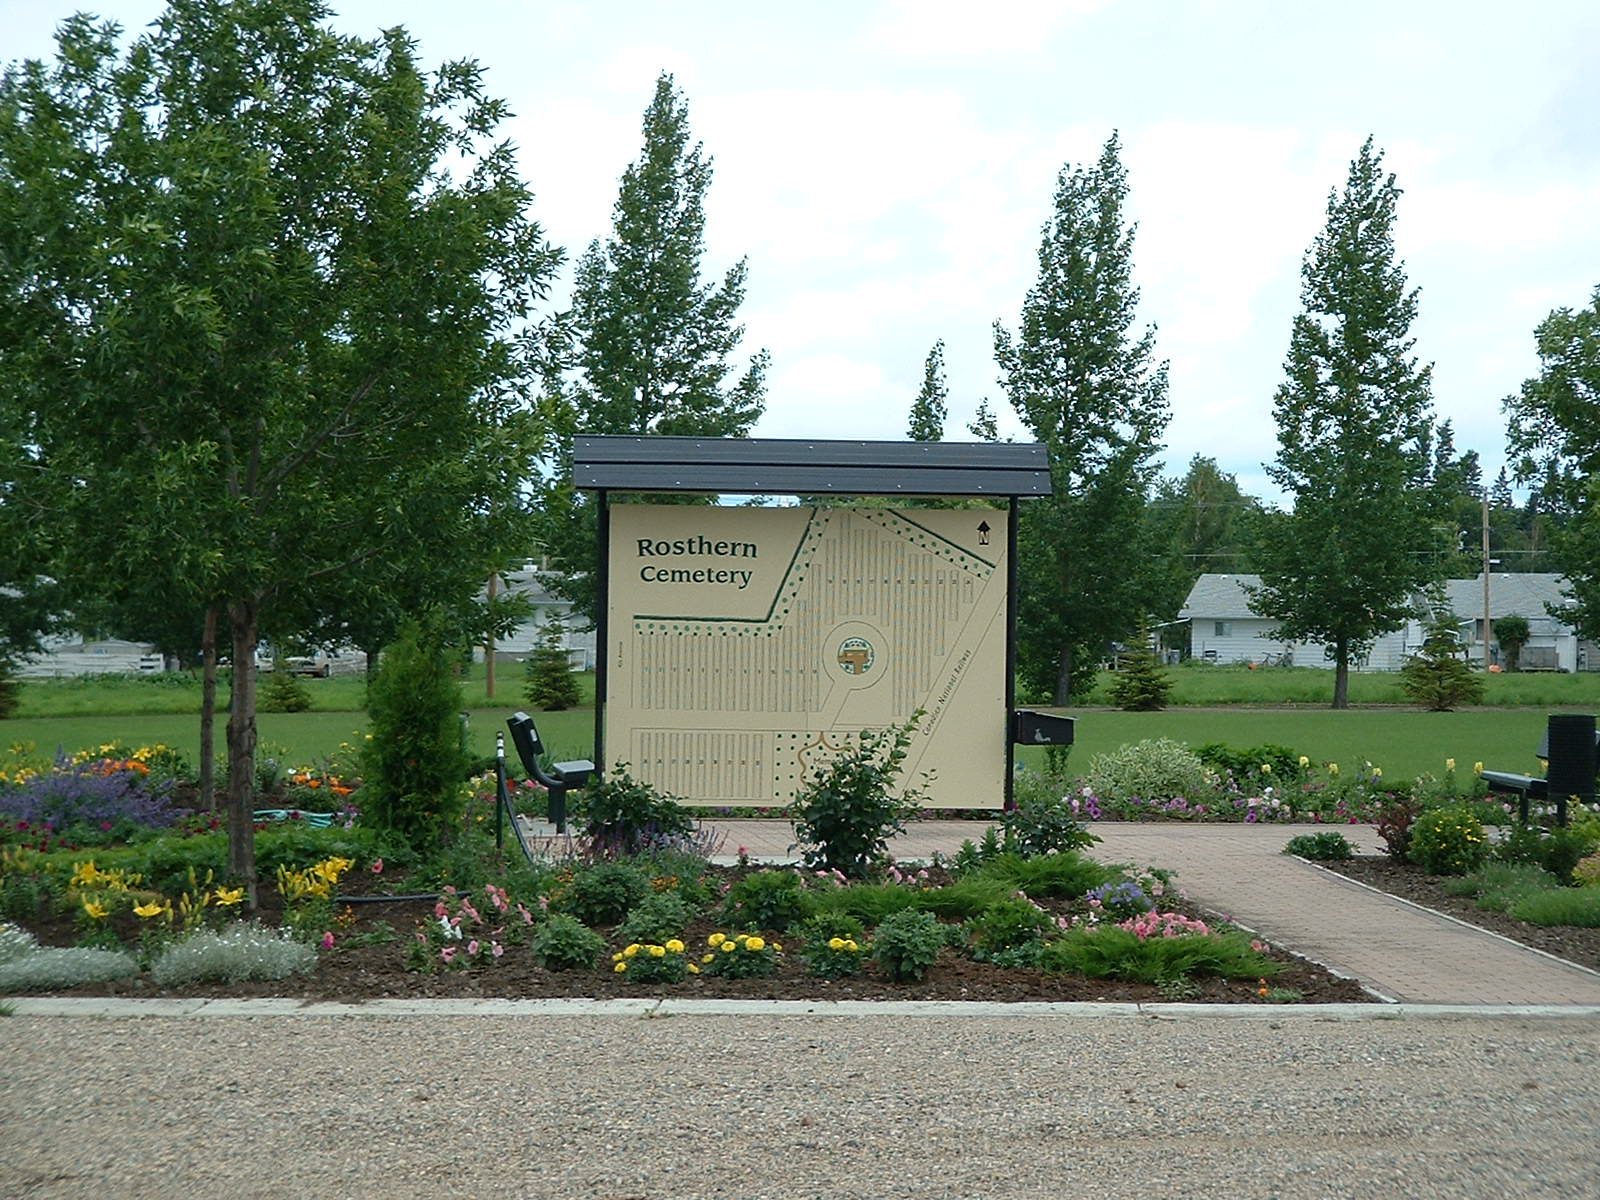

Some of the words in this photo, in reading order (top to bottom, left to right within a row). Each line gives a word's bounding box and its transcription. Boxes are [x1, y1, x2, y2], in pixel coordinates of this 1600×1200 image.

[636, 535, 758, 558] Rosthern
[640, 566, 753, 589] Cemetery
[938, 674, 957, 704] National
[953, 649, 972, 675] Railway
